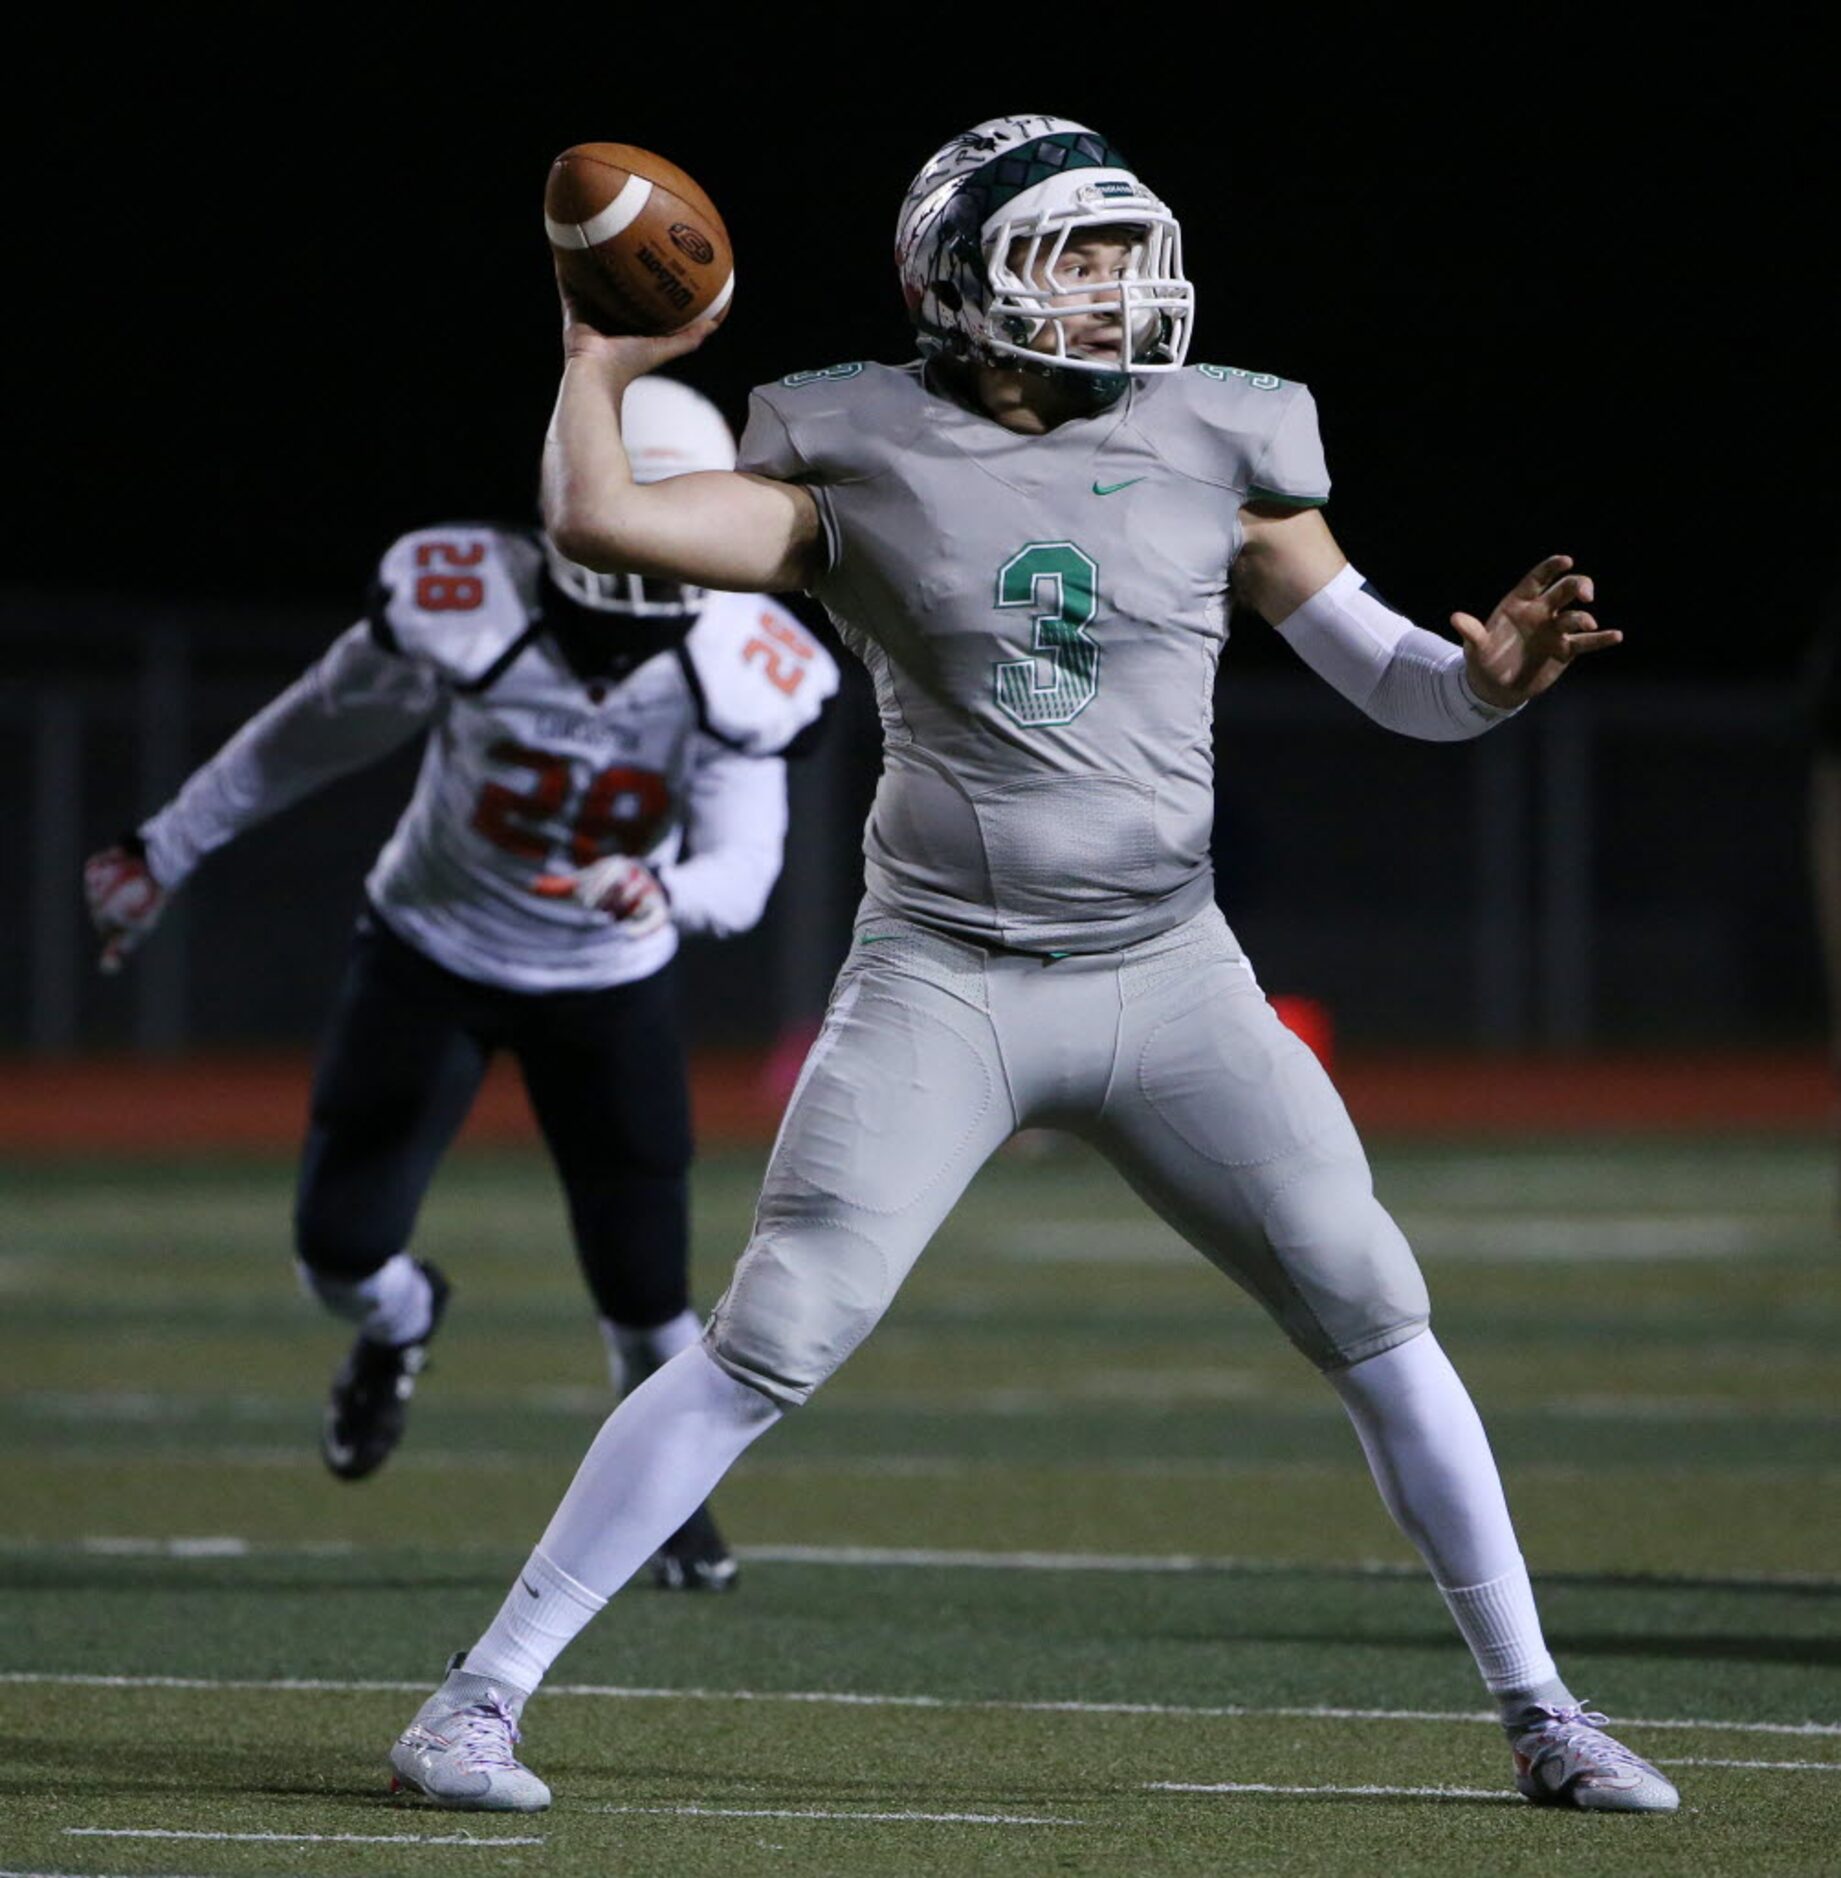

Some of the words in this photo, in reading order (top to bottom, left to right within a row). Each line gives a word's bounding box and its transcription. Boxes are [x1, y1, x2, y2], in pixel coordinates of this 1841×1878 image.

[636, 246, 695, 311] Wilson
[416, 541, 486, 612] 28
[994, 541, 1098, 728] 3
[470, 736, 674, 868] 28
